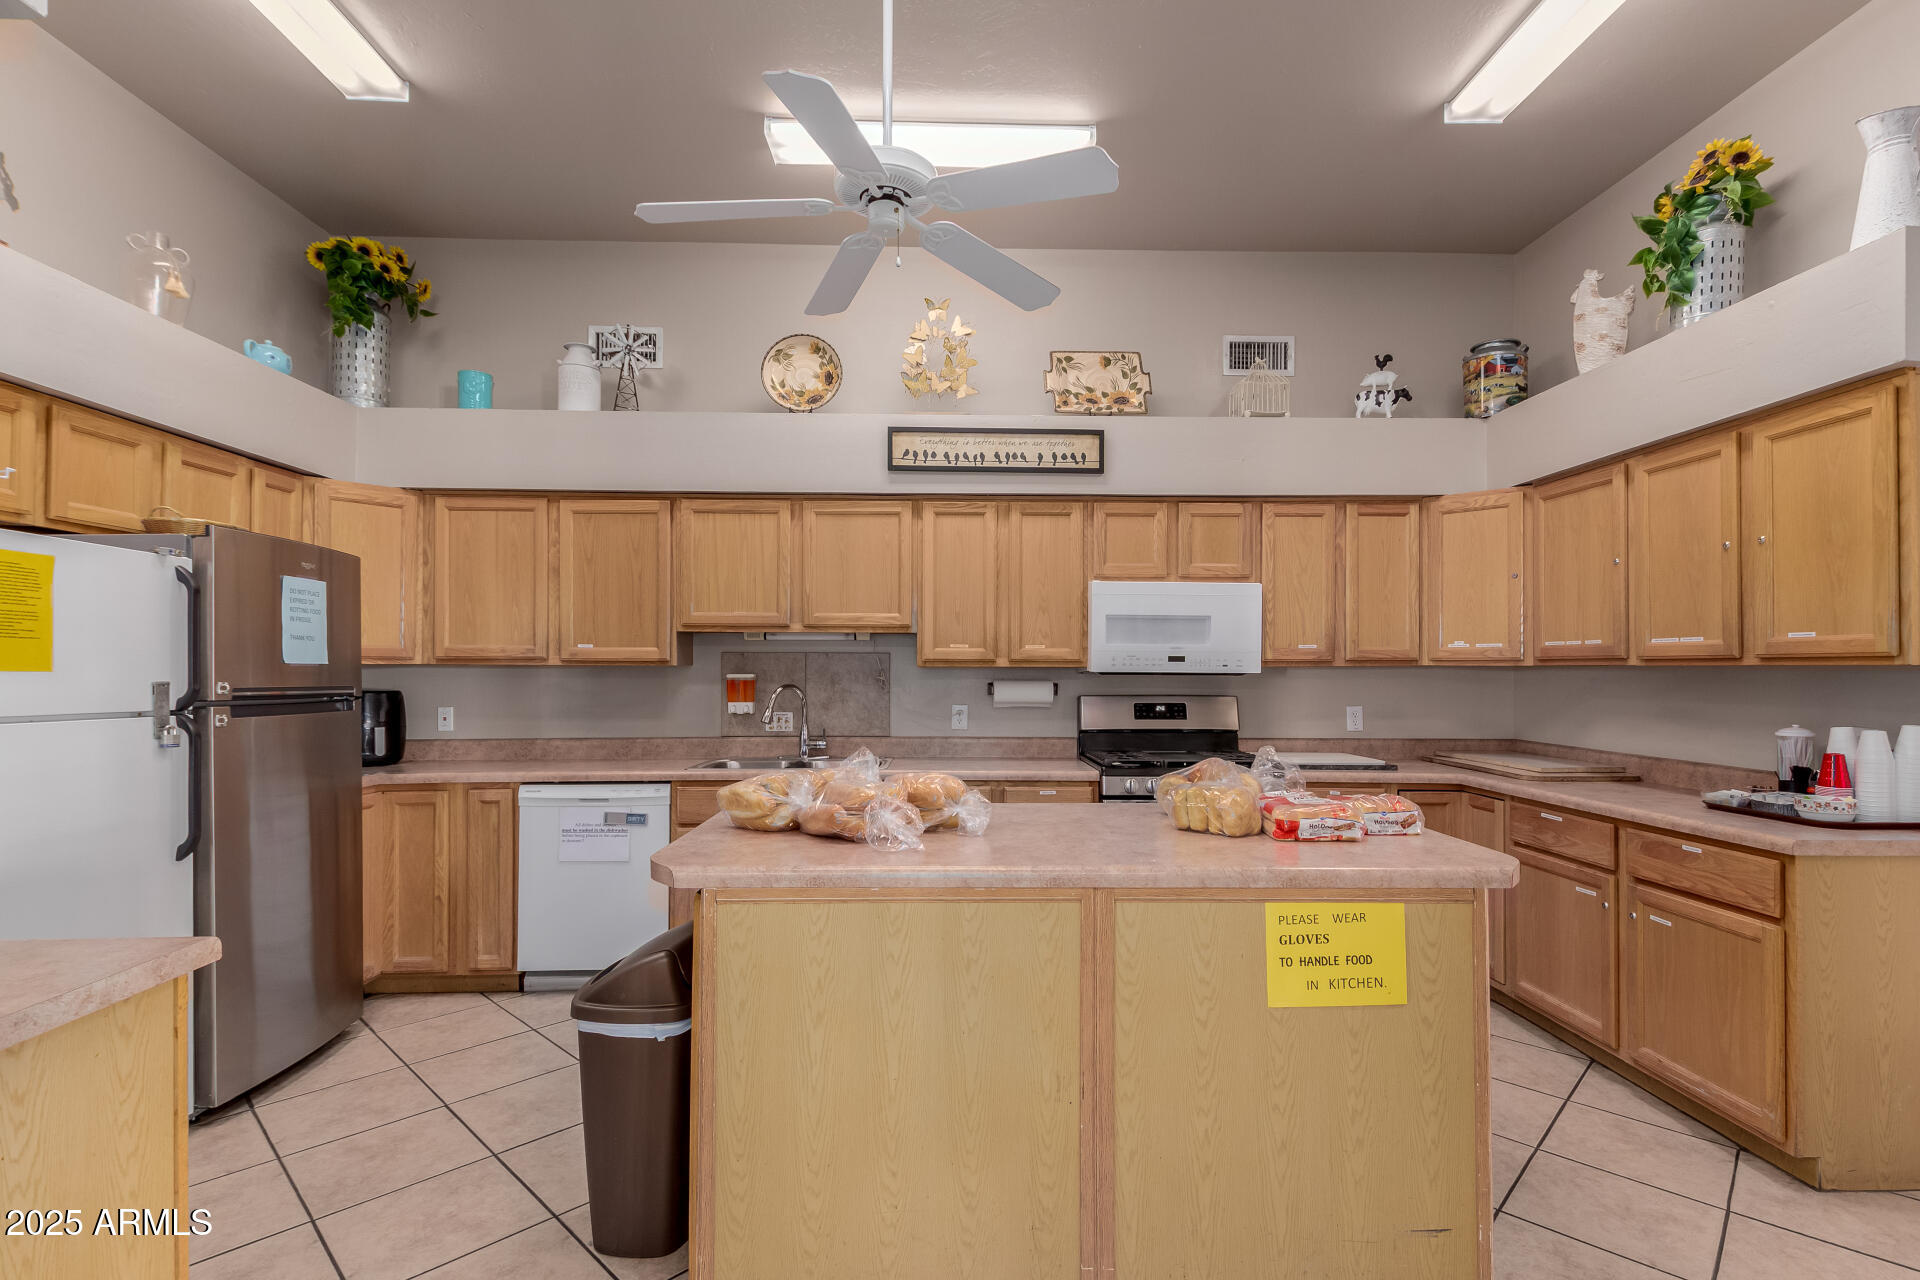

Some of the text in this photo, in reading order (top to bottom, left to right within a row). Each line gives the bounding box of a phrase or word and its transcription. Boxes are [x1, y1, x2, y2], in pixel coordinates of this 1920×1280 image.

[1278, 912, 1367, 925] PLEASE WEAR
[1279, 933, 1330, 945] GLOVES
[1279, 954, 1373, 967] TO HANDLE FOOD
[1306, 976, 1387, 991] IN KITCHEN.
